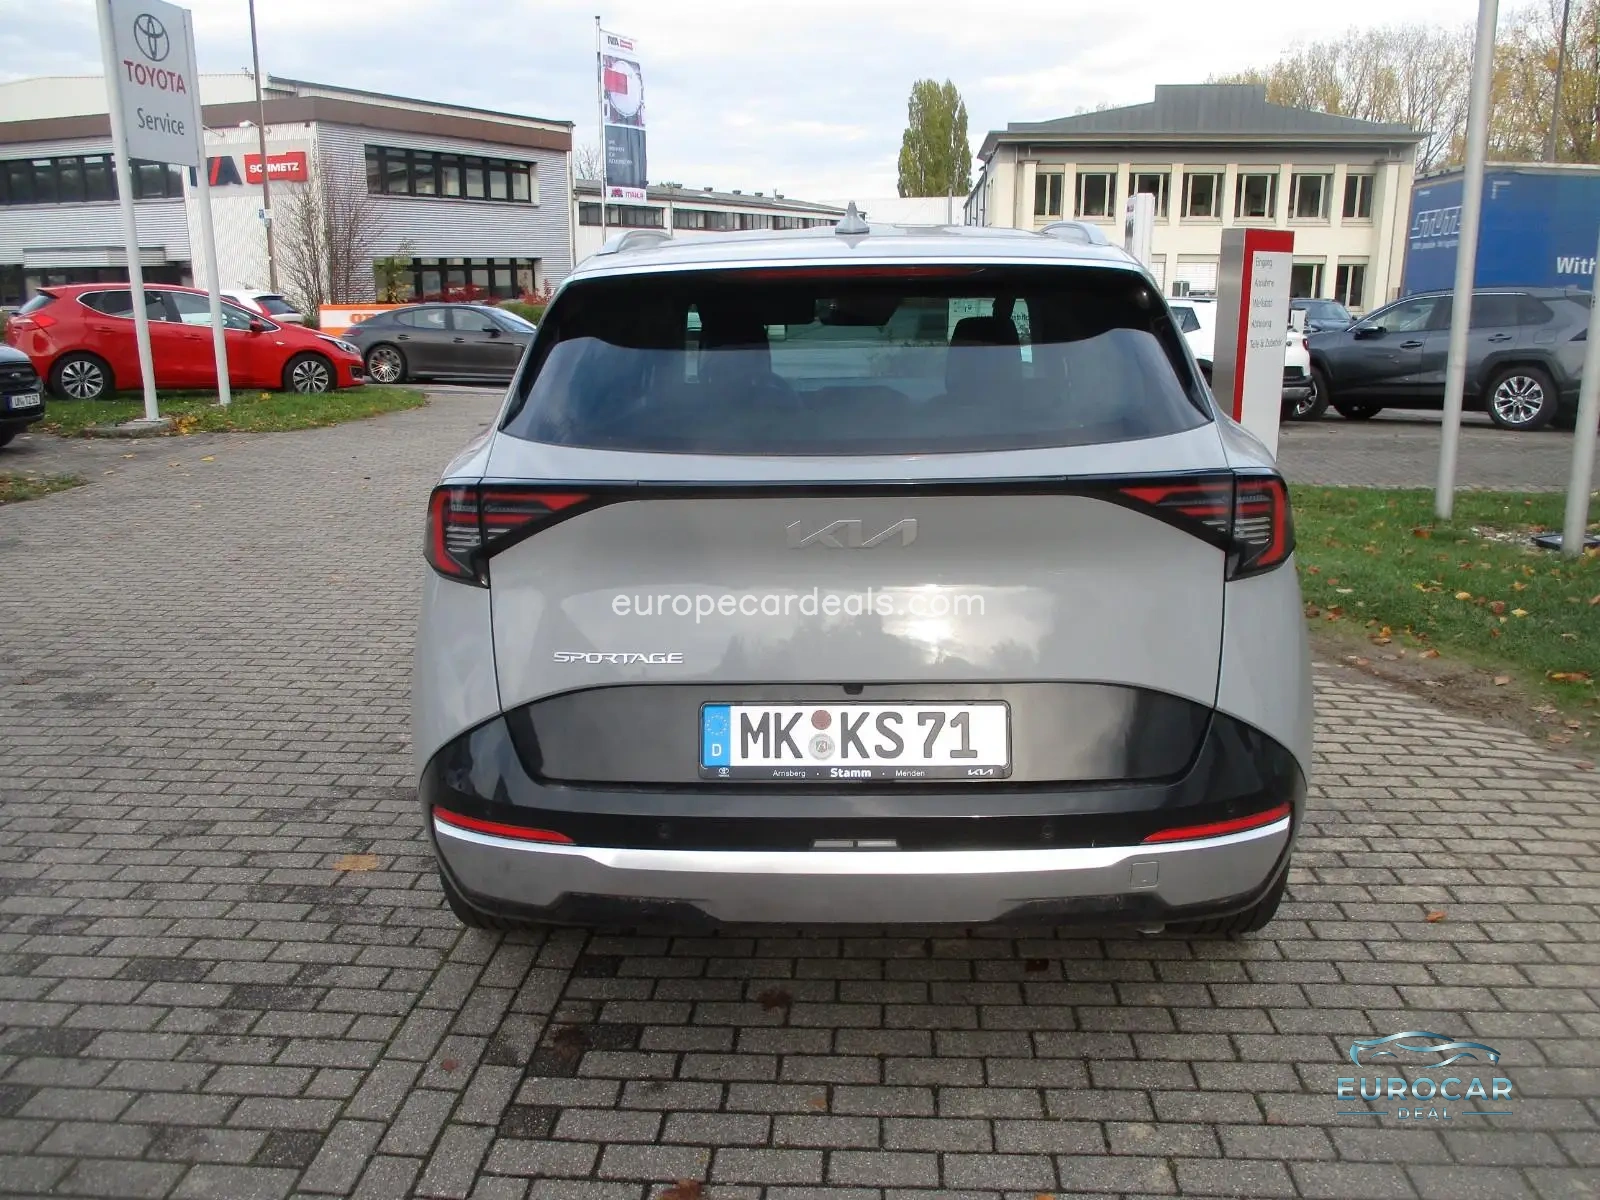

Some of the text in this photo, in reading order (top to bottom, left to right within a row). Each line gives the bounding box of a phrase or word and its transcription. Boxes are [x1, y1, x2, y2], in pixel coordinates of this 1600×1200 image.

[123, 60, 186, 94] TOYOTA
[137, 107, 184, 135] Service
[786, 518, 918, 549] KIA
[553, 651, 684, 665] SPORTAGE
[740, 711, 978, 759] MK KS 71
[711, 743, 722, 757] D
[772, 767, 994, 778] Arnsberg Stamm Menden KIA
